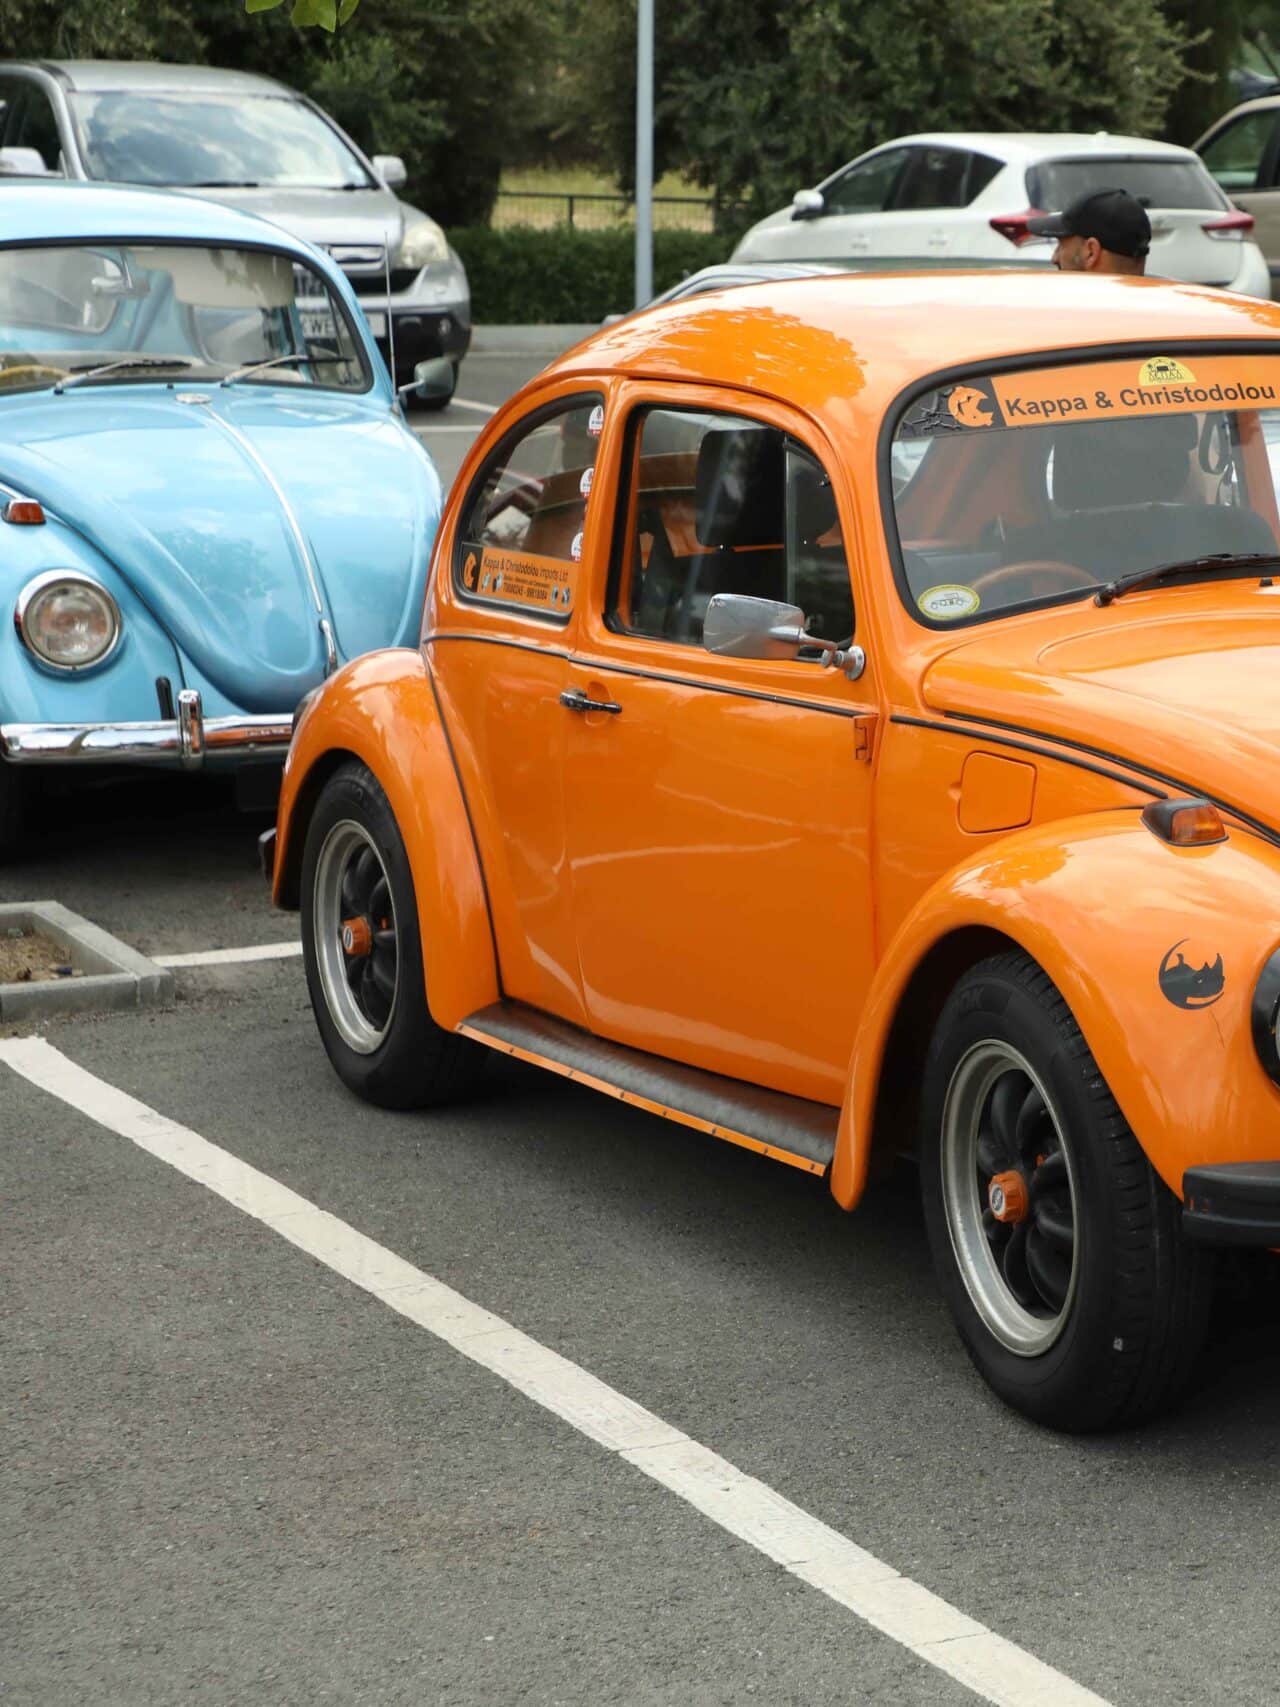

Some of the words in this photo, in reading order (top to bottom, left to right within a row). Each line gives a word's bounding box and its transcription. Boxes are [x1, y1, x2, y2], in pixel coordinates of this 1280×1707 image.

[1006, 396, 1088, 418] Kappa
[1095, 391, 1114, 408] &
[1119, 382, 1276, 407] Christodolou
[484, 556, 499, 572] Kappa
